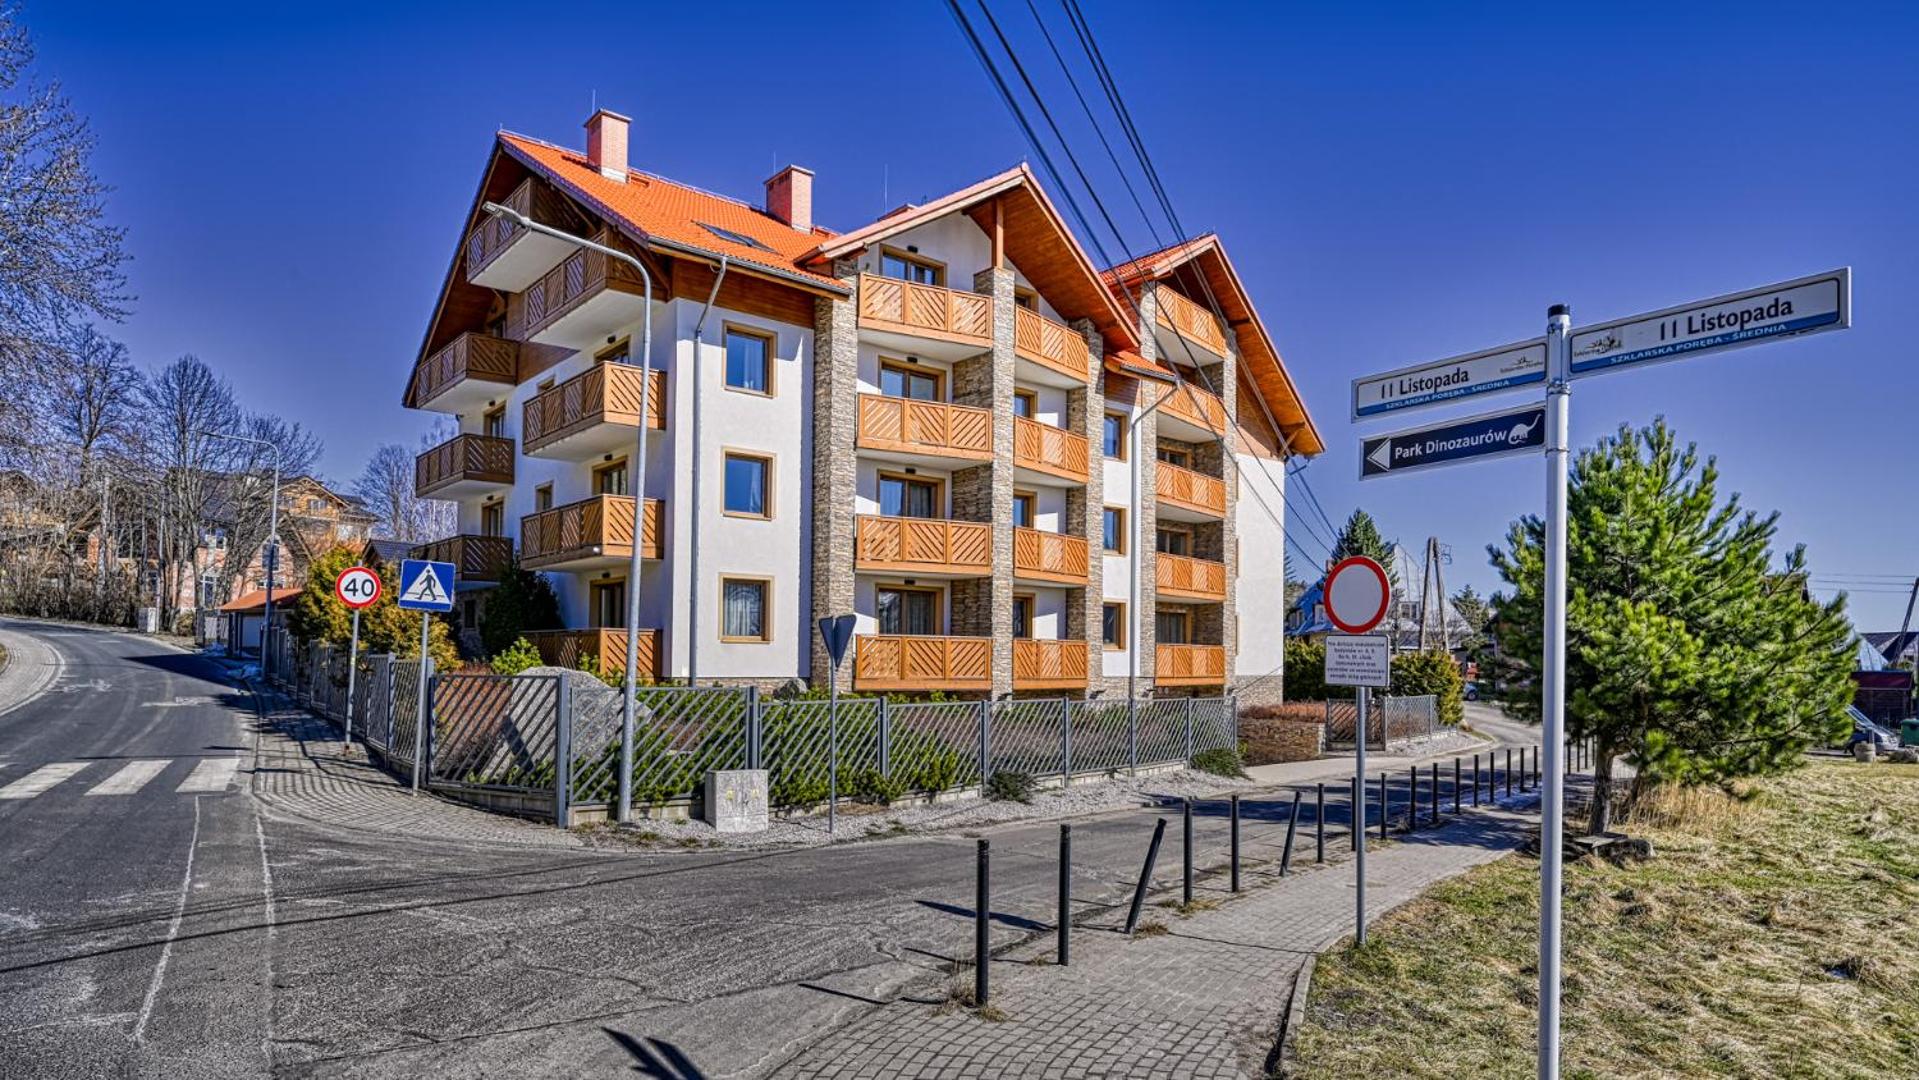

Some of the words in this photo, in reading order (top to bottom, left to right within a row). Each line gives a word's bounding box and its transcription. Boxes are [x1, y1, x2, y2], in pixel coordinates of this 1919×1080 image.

[1687, 296, 1794, 335] Listopada
[1610, 345, 1674, 365] SZKLARSKA
[1400, 367, 1470, 395] Listopada
[1394, 443, 1422, 460] Park
[1425, 429, 1508, 454] Dinozaurów
[343, 577, 375, 597] 40
